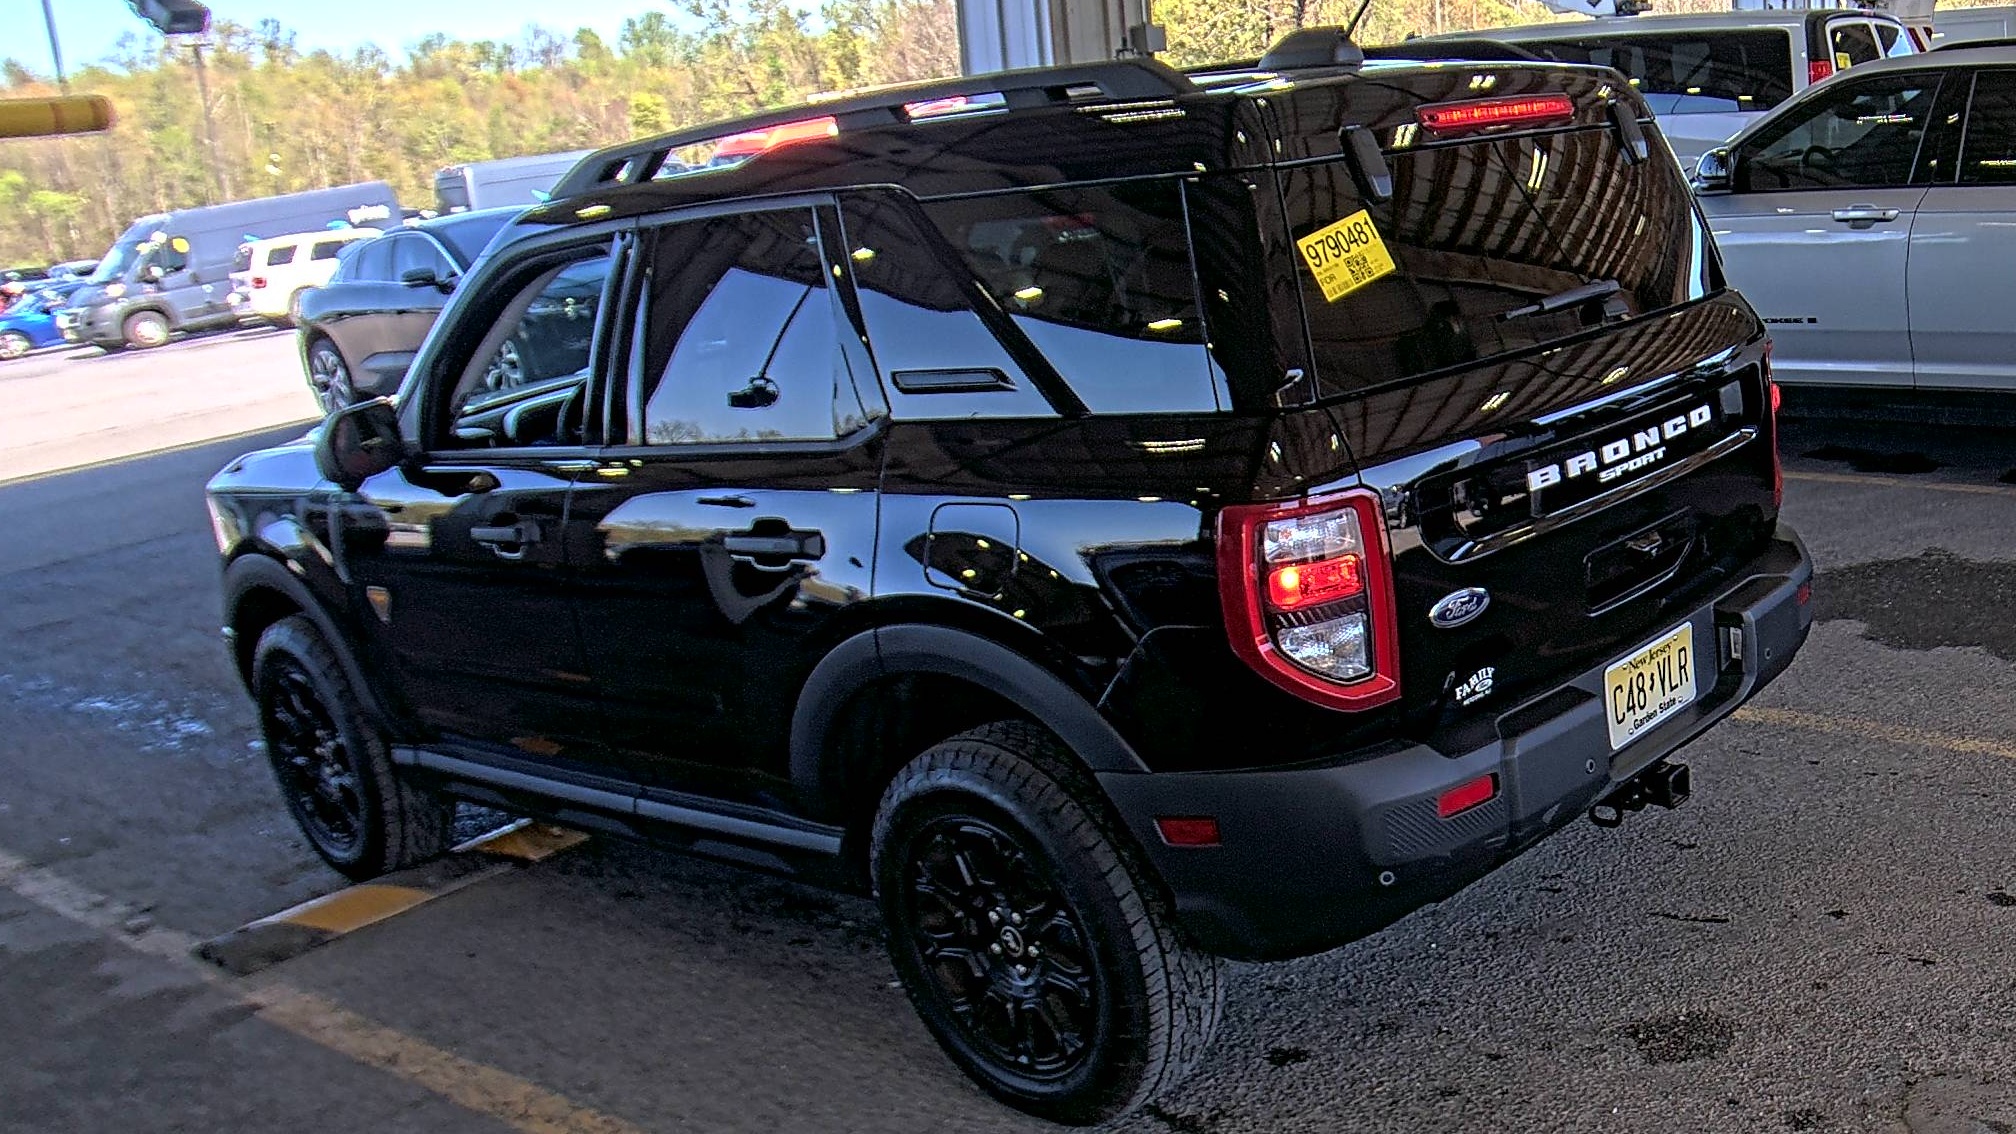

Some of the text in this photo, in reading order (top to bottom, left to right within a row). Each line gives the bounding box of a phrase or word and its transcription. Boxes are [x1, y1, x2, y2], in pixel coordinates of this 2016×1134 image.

[1305, 217, 1377, 268] 9790481
[1527, 404, 1712, 492] BRONCO
[1599, 447, 1667, 483] SPORT
[1445, 595, 1478, 620] Ford
[1627, 641, 1673, 674] New Jersey
[1633, 696, 1677, 730] Garden State
